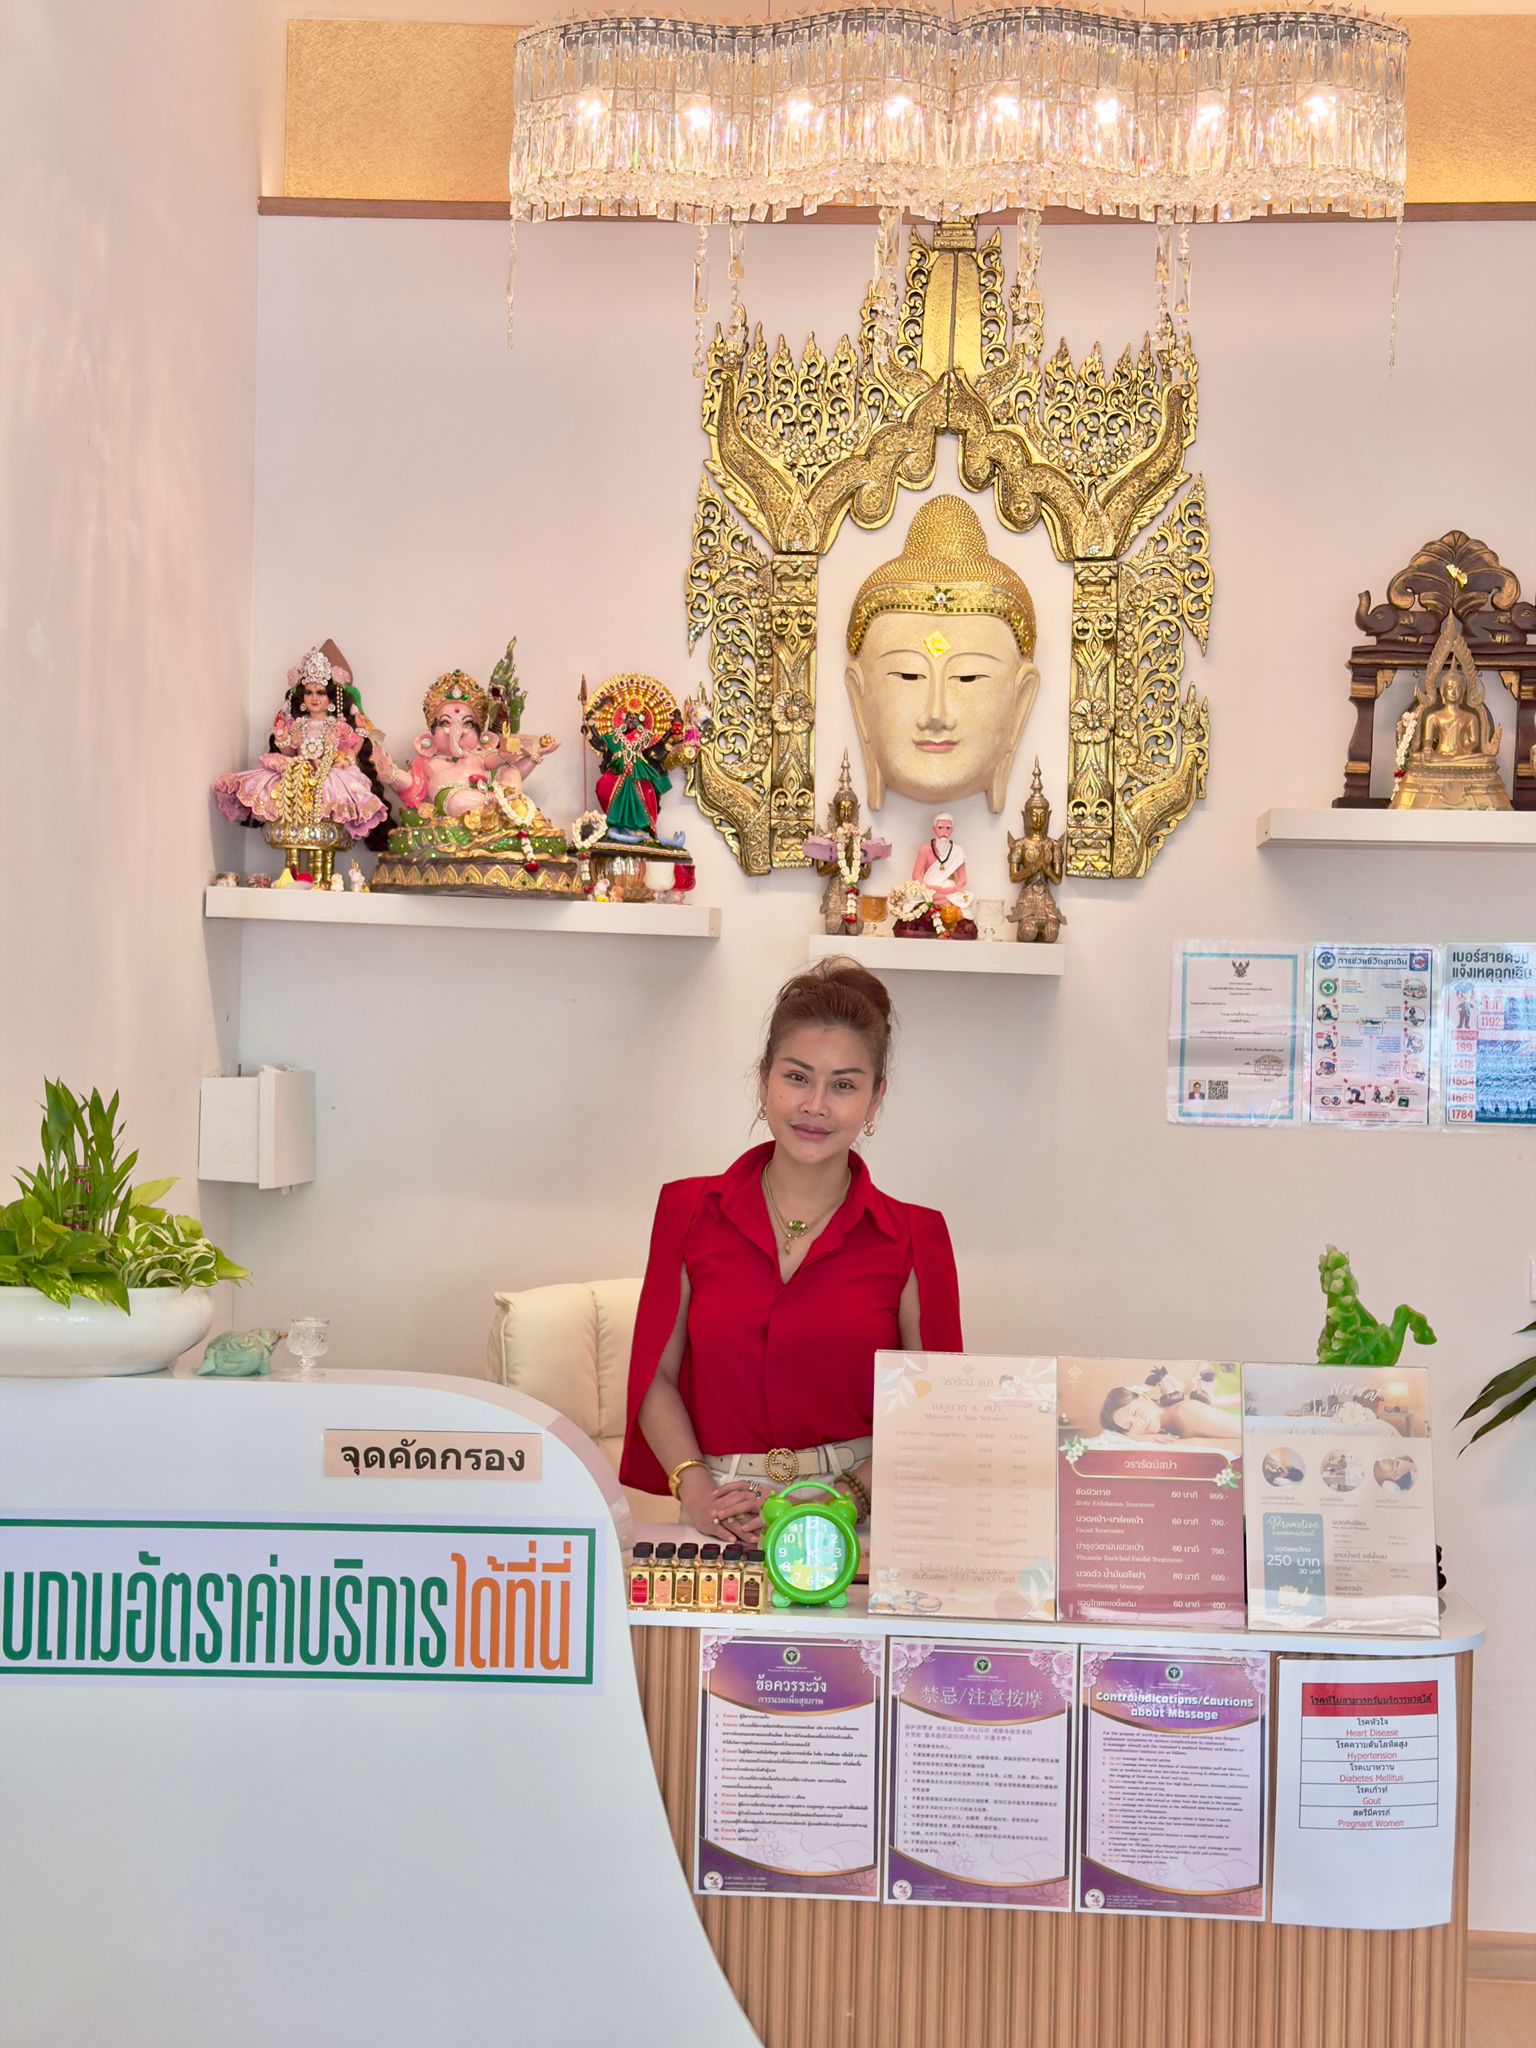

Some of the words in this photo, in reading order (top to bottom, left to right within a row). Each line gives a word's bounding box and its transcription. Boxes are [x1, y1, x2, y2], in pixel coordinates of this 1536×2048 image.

[1451, 1109, 1474, 1120] 1784
[340, 1438, 525, 1475] จุดคัดกรอง
[1171, 1491, 1182, 1499] 60
[1171, 1518, 1182, 1526] 60
[1266, 1514, 1321, 1530] Promotion
[1172, 1545, 1183, 1553] 60
[1266, 1554, 1292, 1567] 250
[1296, 1557, 1321, 1568] บาท
[1172, 1573, 1183, 1581] 60
[1173, 1600, 1184, 1608] 60
[755, 1674, 827, 1693] ข้อควรระวัง
[758, 1692, 824, 1708] การนวดเพื่อสุขภาพ
[920, 1684, 1043, 1710] 禁忌/注意按摩
[1096, 1691, 1254, 1708] Contraindications/Cautions
[1131, 1707, 1165, 1718] about
[1167, 1708, 1219, 1721] Massage
[1356, 1717, 1389, 1726] โรคหัวใจ
[1346, 1729, 1367, 1737] Heart
[1369, 1729, 1399, 1737] Disease
[1336, 1740, 1408, 1750] โรคความดันโลหิตสูง
[1347, 1751, 1397, 1761] Hypertension
[1350, 1763, 1395, 1771] โรคเบาหวาน
[1339, 1774, 1373, 1782] Diabetes
[1375, 1773, 1404, 1782] Mellitus
[1362, 1796, 1381, 1805] Gout
[1338, 1819, 1374, 1830] Pregnant
[1375, 1819, 1404, 1828] Women
